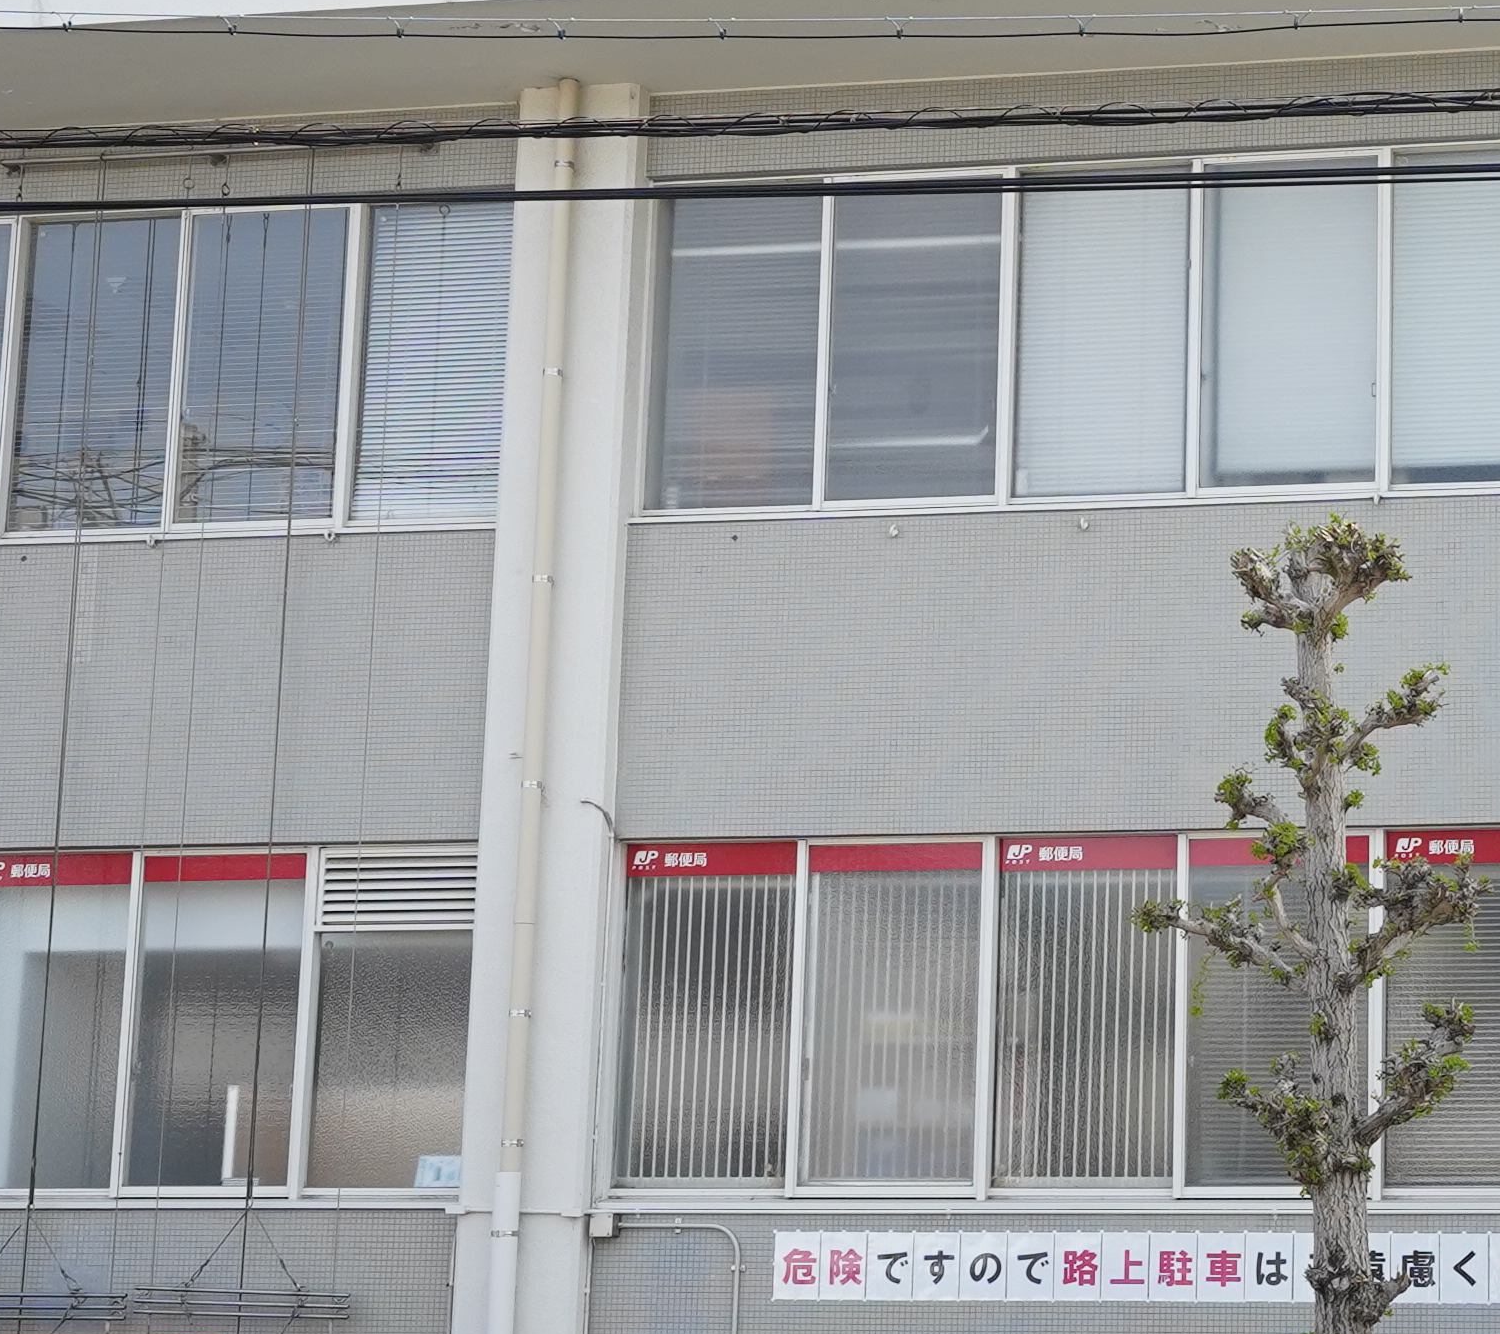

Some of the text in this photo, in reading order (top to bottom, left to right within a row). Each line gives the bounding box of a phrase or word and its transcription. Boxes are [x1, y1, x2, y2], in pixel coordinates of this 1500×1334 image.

[1038, 845, 1084, 862] 郵便局
[1428, 838, 1476, 856] 郵便局
[664, 852, 708, 867] 郵便局
[9, 863, 51, 879] 郵便局
